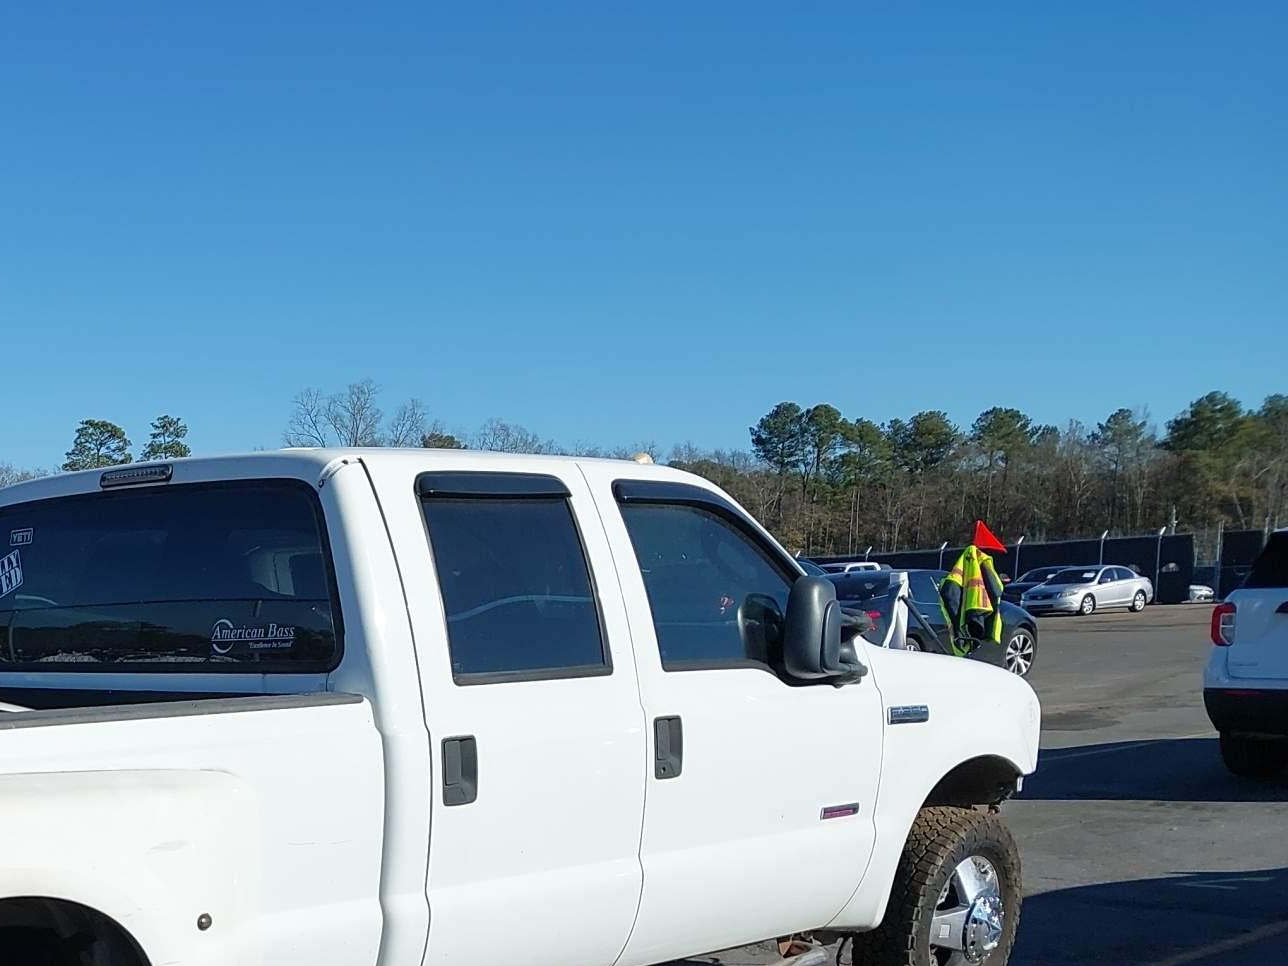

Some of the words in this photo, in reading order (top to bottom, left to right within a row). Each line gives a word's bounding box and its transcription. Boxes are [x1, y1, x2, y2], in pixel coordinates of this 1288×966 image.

[12, 531, 31, 543] YETI
[211, 625, 264, 639] American
[268, 623, 295, 637] Bass
